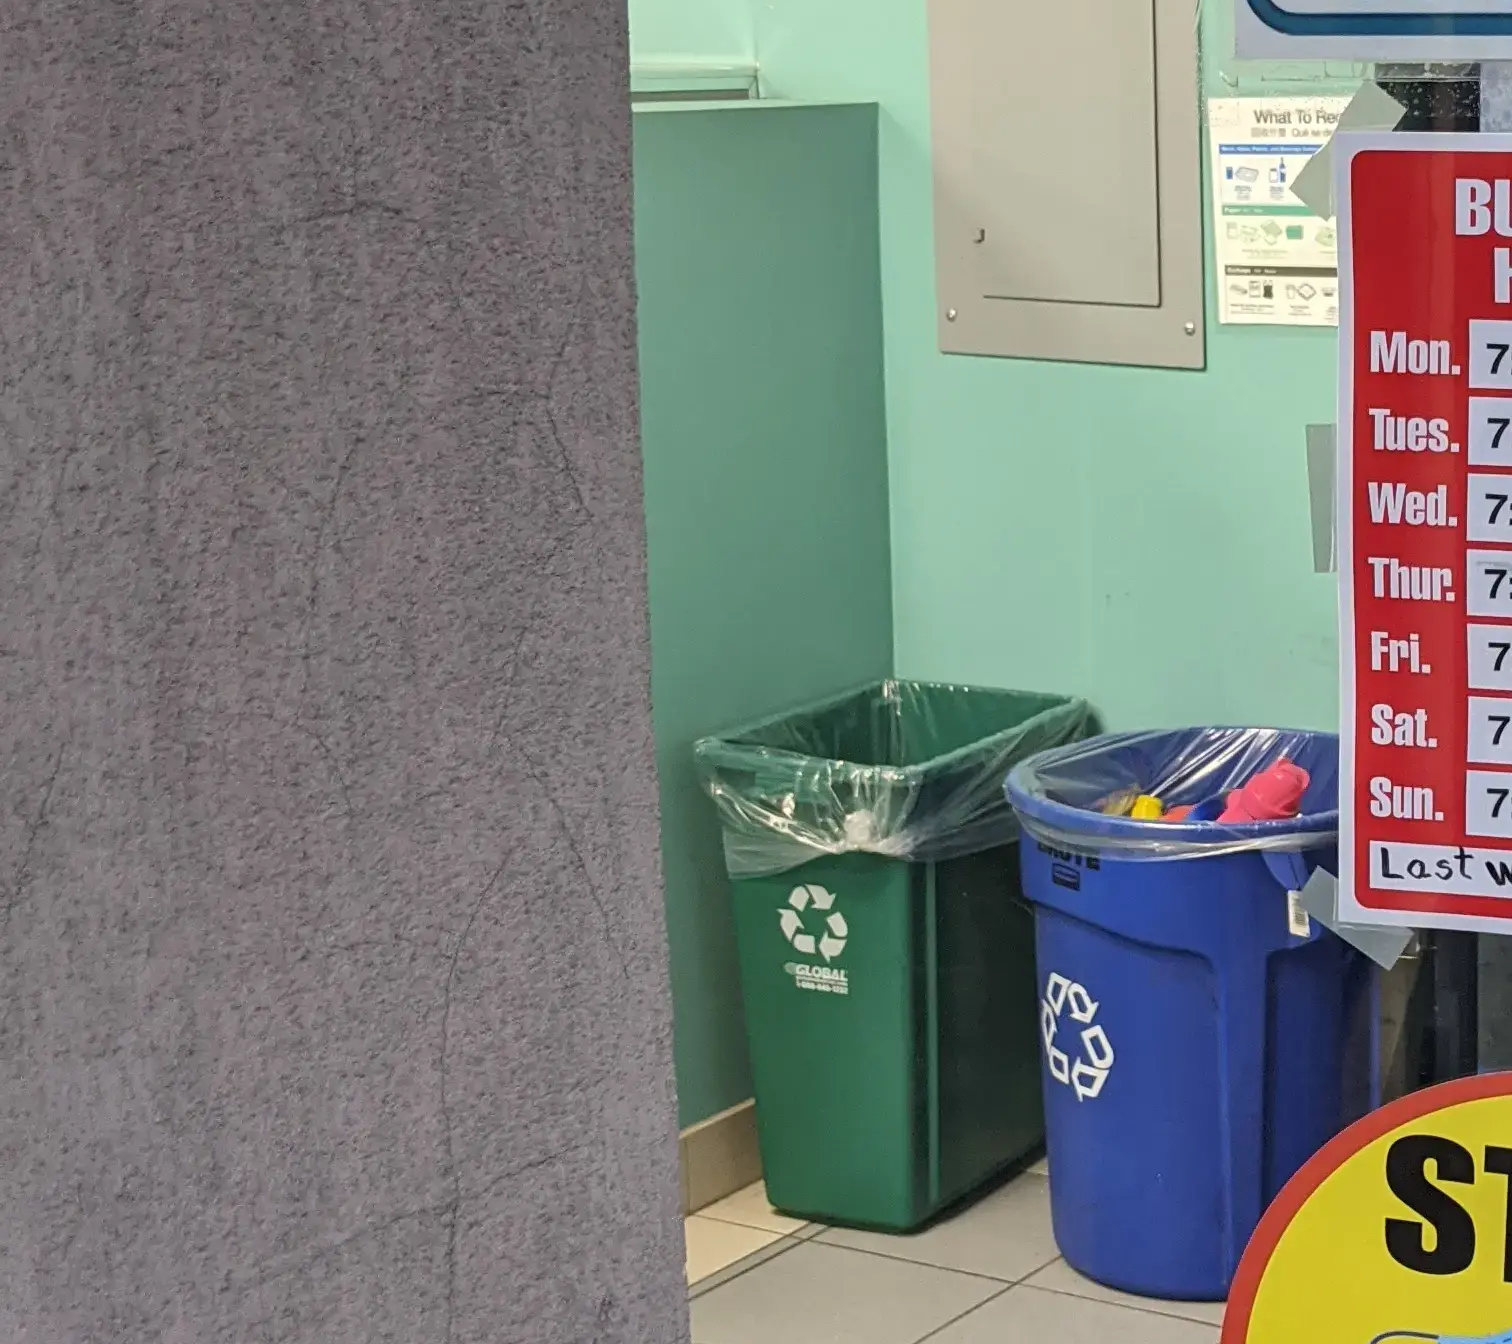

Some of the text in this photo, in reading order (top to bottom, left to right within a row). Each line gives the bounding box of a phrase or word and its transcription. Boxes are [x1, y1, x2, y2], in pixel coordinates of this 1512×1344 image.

[1253, 107, 1293, 125] What
[1296, 108, 1312, 125] To
[1369, 330, 1461, 377] Mon.
[1368, 407, 1460, 454] Tues.
[1367, 481, 1459, 527] Wed.
[1368, 556, 1456, 602] Thur.
[1370, 631, 1432, 675] Fri.
[1370, 704, 1439, 748] Sat.
[1369, 777, 1444, 821] Sun.
[1380, 844, 1474, 881] Last
[796, 964, 849, 982] GLOBAL
